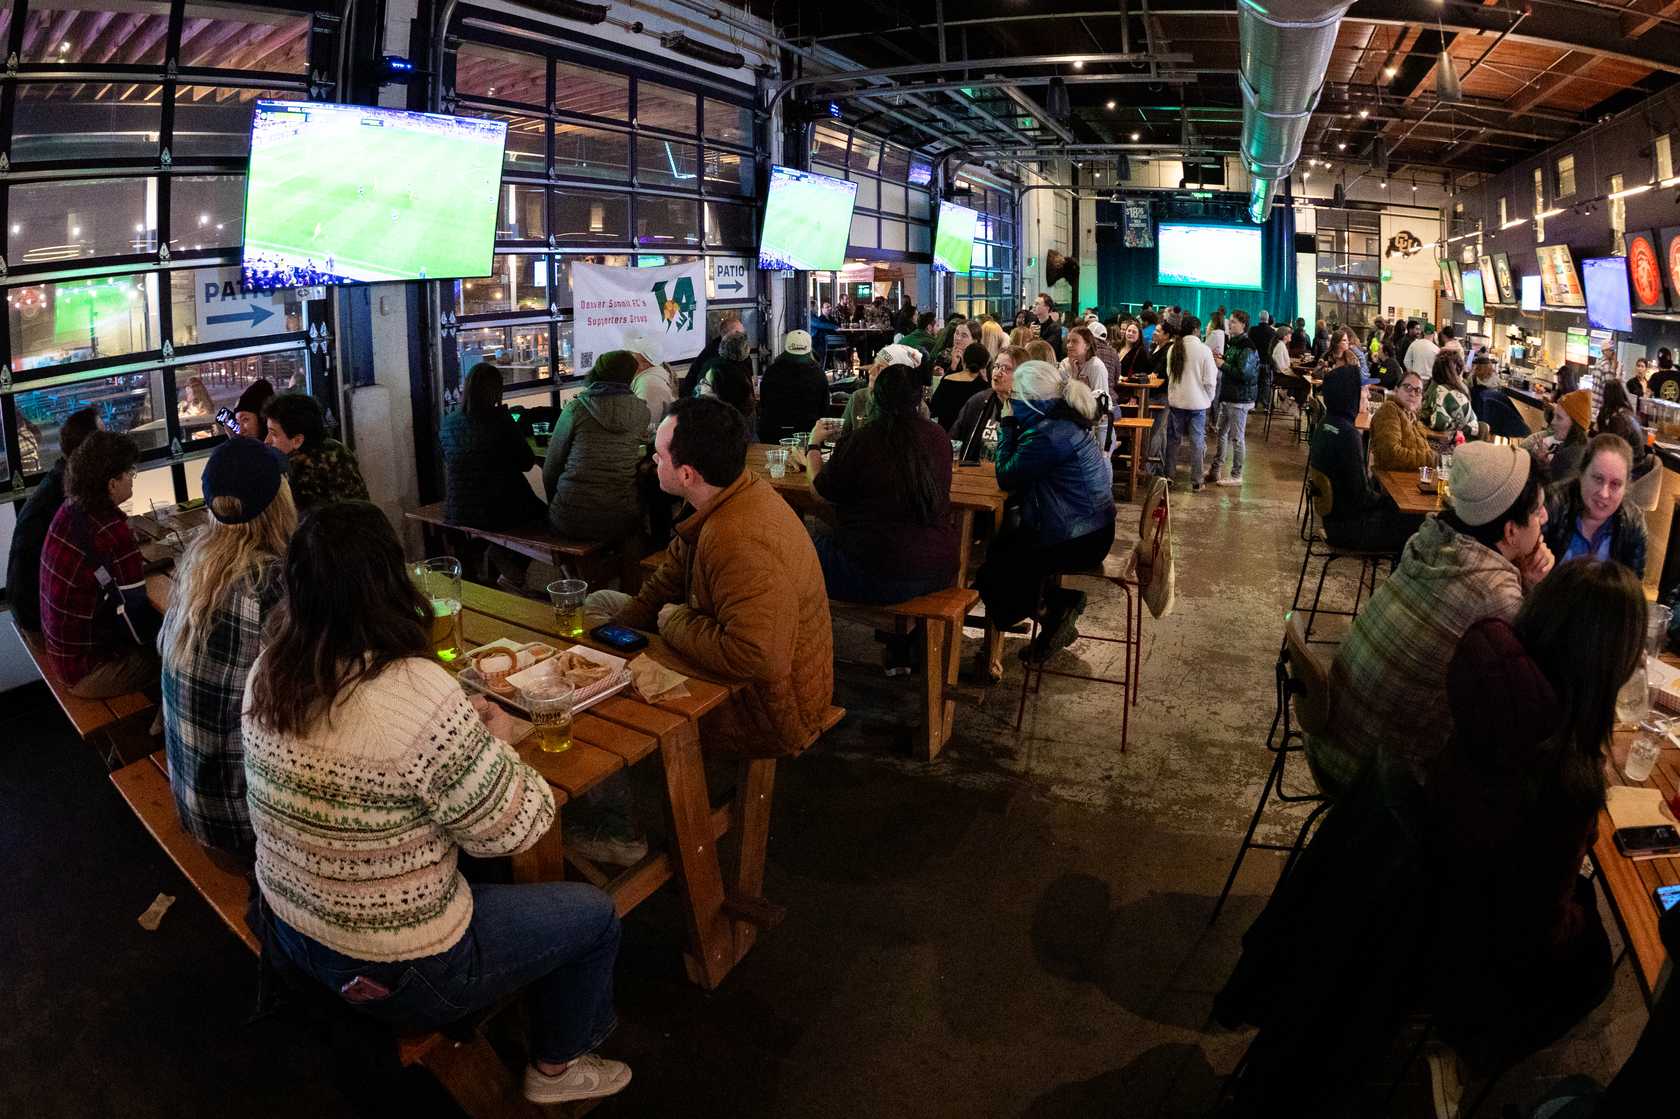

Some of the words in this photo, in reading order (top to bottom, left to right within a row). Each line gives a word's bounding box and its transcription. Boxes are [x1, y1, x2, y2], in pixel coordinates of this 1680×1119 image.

[717, 264, 745, 277] PATIO
[580, 299, 605, 310] Denver
[608, 298, 631, 308] Summit
[631, 298, 647, 308] FC's
[587, 315, 628, 327] Supporters
[629, 314, 648, 324] Group
